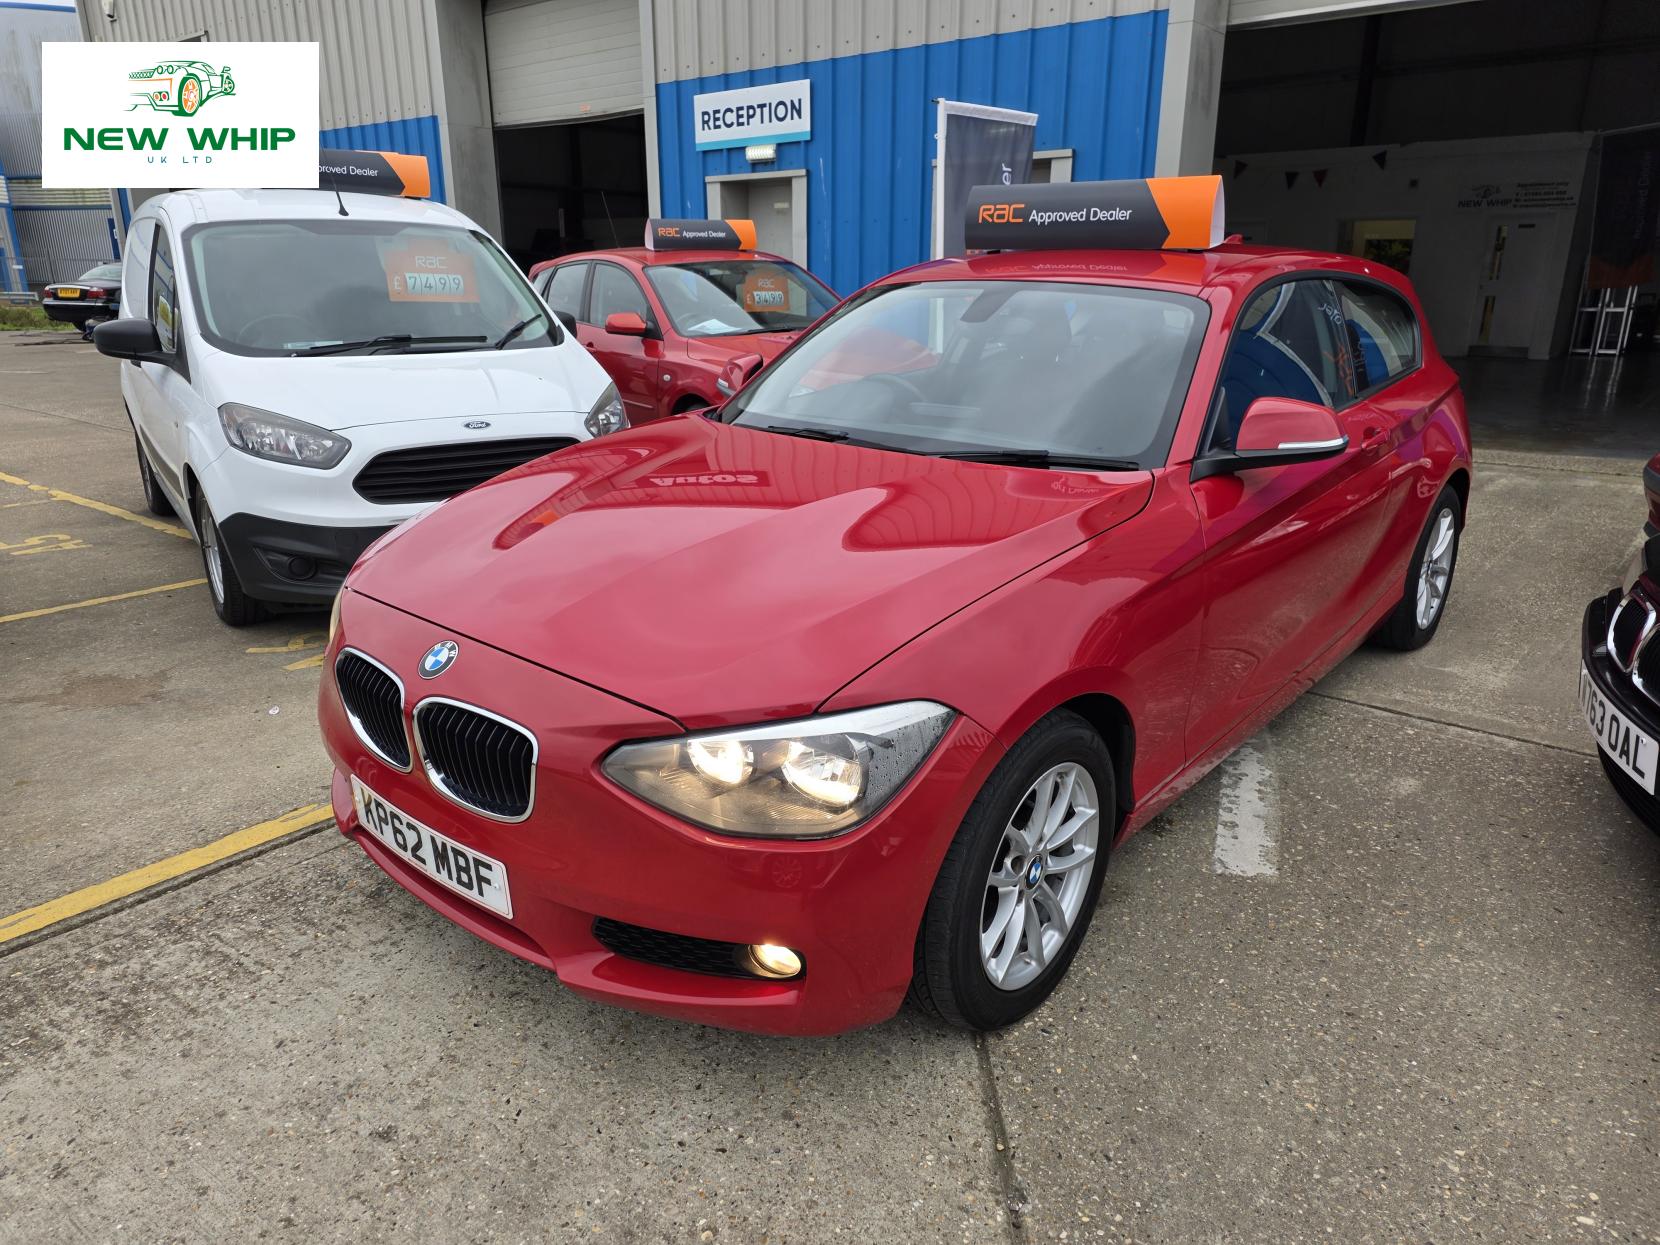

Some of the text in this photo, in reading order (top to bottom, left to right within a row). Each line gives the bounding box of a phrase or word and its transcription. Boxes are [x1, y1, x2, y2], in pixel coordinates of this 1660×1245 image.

[701, 98, 802, 132] RECEPTION
[349, 166, 378, 177] Dealer
[1028, 208, 1087, 226] Approved
[1089, 207, 1133, 222] Dealer
[682, 230, 708, 239] Approved
[708, 230, 727, 238] Dealer
[408, 275, 462, 291] 7499
[755, 291, 784, 305] 3499
[1607, 713, 1646, 780] OAL
[360, 787, 493, 898] KP62 MBF
